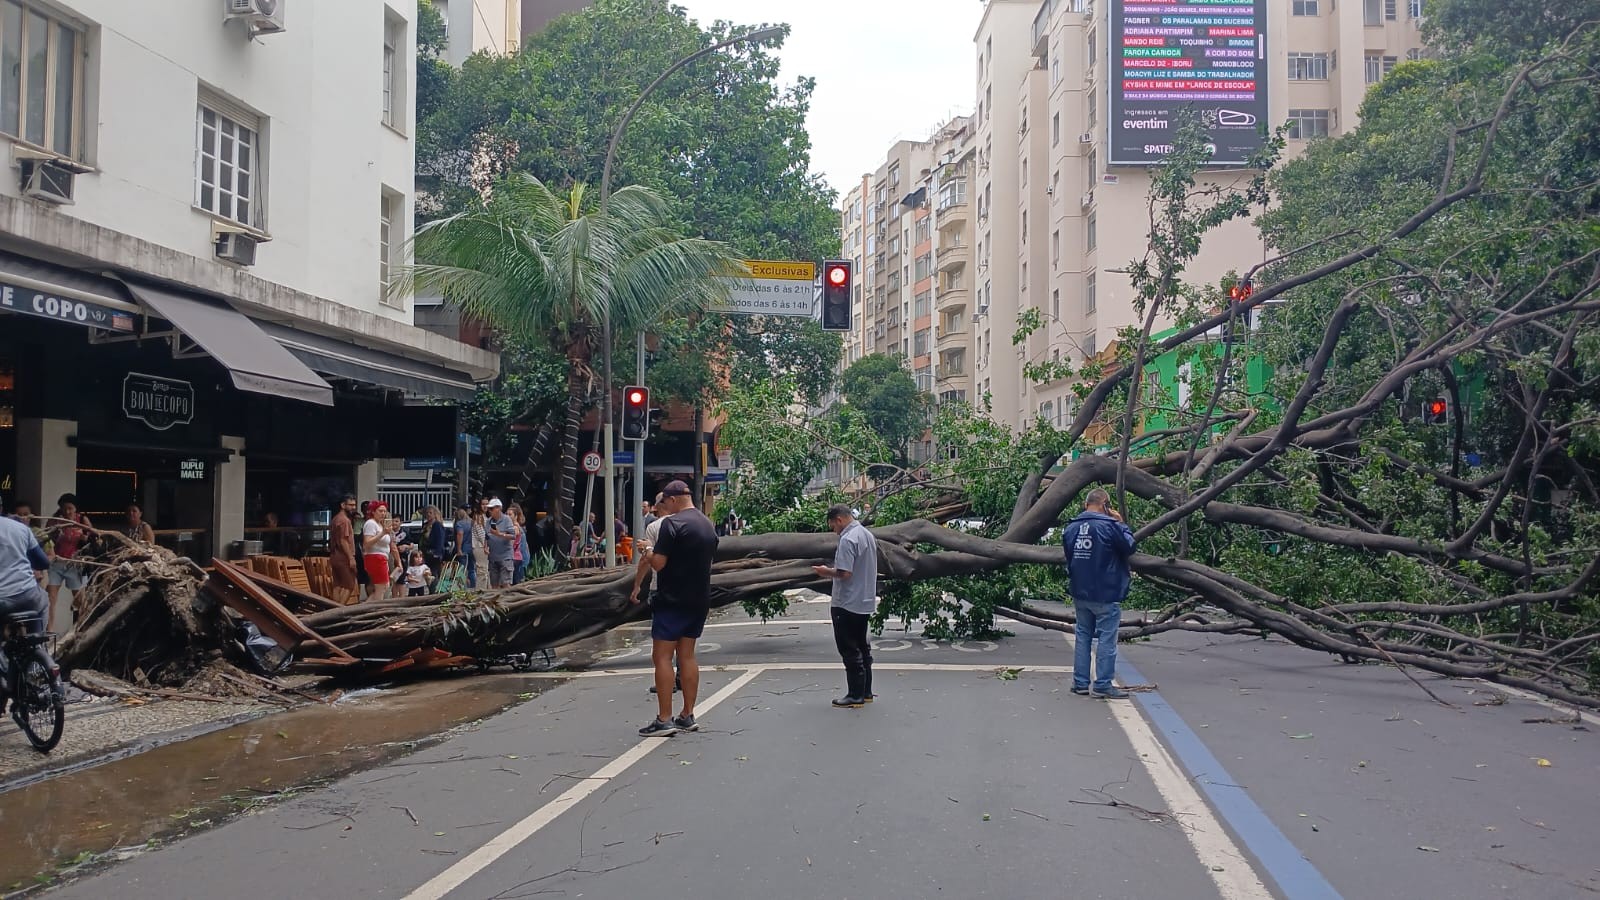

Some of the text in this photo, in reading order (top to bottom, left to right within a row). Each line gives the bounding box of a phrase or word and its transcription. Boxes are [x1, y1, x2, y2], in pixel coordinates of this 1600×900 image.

[1124, 109, 1156, 117] ingressos
[1123, 118, 1168, 129] eventim
[752, 265, 808, 275] Exclusivas
[0, 286, 87, 321] E COPO
[131, 390, 153, 410] BOM
[163, 395, 188, 414] COPO
[181, 461, 204, 470] DUPLO
[586, 456, 599, 466] 30
[181, 470, 204, 479] MALTE
[1074, 538, 1092, 550] RIO
